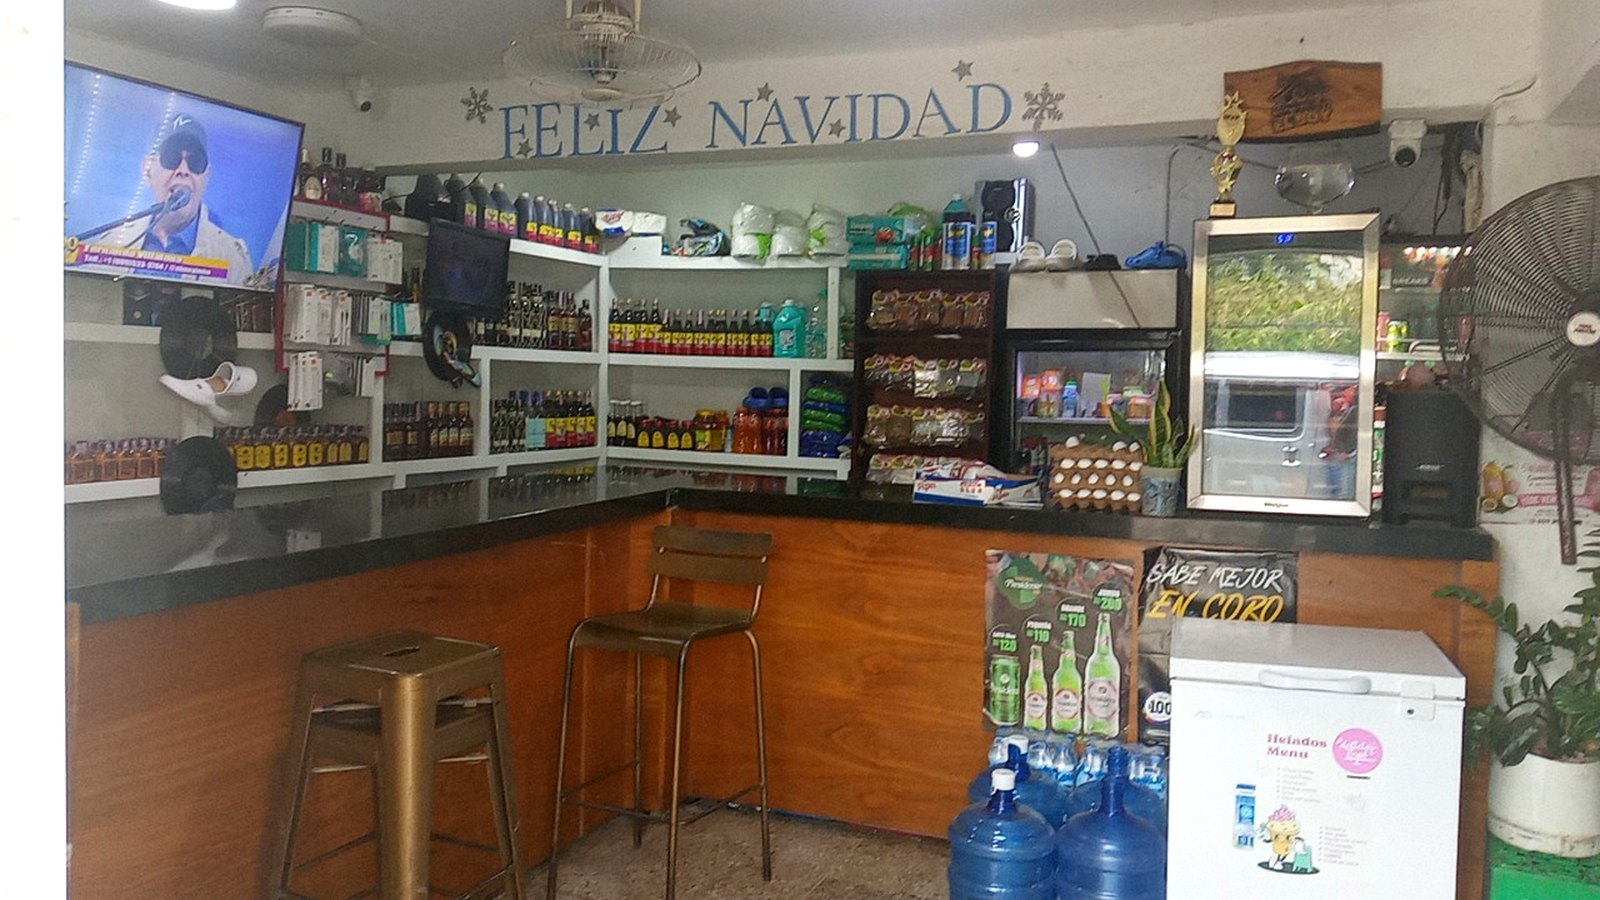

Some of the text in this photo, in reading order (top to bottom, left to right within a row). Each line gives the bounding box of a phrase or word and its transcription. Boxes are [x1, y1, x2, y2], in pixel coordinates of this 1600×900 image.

[499, 83, 1013, 160] FELIZ NAVIDAD
[1147, 564, 1283, 593] SABE MEJOR
[1147, 588, 1285, 622] EN CORO
[1267, 733, 1328, 748] Helados
[1267, 745, 1309, 759] Menu
